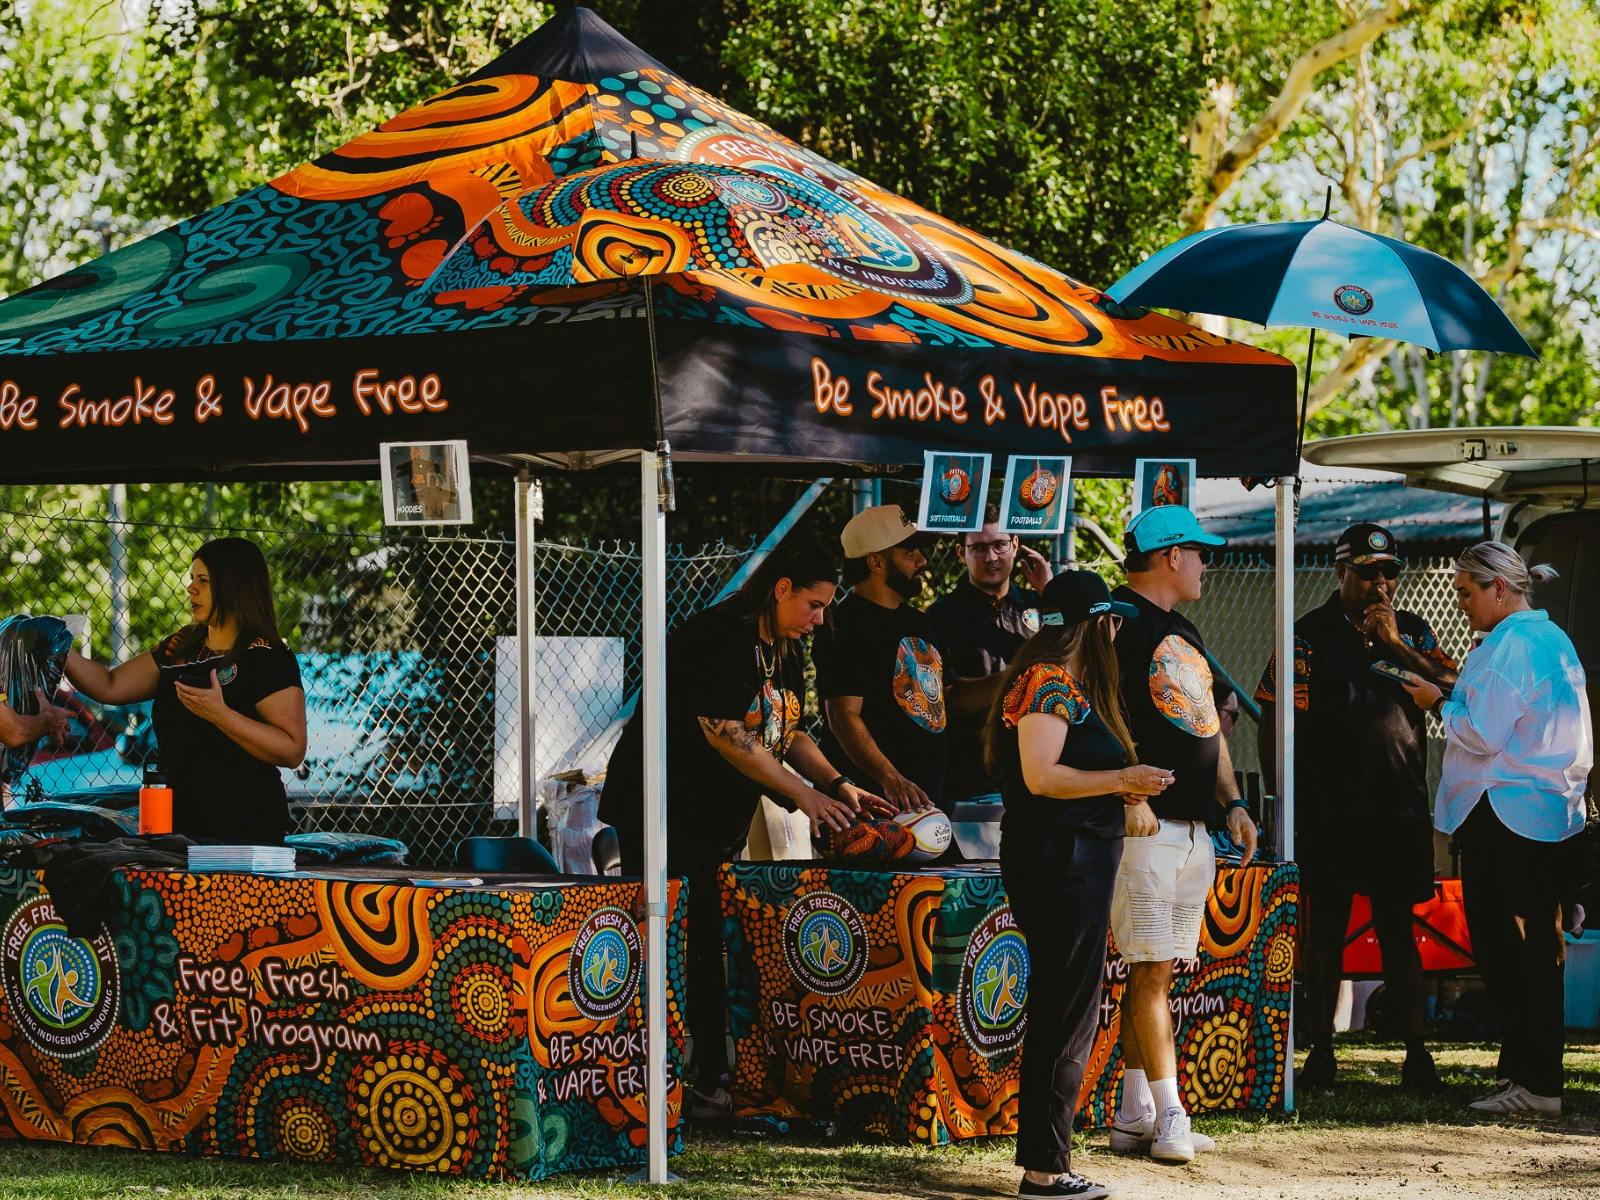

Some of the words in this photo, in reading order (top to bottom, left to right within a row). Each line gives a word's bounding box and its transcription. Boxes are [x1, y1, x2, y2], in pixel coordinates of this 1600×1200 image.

[708, 139, 794, 169] FRESH
[835, 185, 885, 216] FIT
[0, 380, 38, 430] Be
[60, 376, 175, 429] Smoke
[196, 374, 223, 422] &
[243, 374, 336, 433] Vape
[353, 369, 448, 416] Free
[811, 357, 853, 416] Be
[866, 370, 969, 424] Smoke
[979, 374, 1005, 425] &
[1014, 381, 1090, 444] Vape
[1101, 386, 1171, 433] Free
[397, 505, 423, 513] HOODIES
[1010, 516, 1043, 525] FOOTBALLS
[7, 917, 33, 961] FREE,
[31, 904, 65, 925] FRE
[93, 935, 112, 963] FIT
[594, 913, 622, 929] FRESH
[620, 922, 629, 936] &
[626, 933, 638, 951] FIT
[789, 905, 810, 933] FREE,
[809, 897, 842, 913] FRESH
[841, 908, 850, 921] &
[848, 919, 862, 937] FIT
[967, 927, 994, 968] FREE,
[995, 912, 1018, 932] FRE
[178, 958, 253, 999] Free,
[266, 962, 349, 1000] Fresh
[621, 968, 637, 1000] SMOKING
[790, 947, 810, 978] TACKLING
[809, 975, 846, 988] INDIGENOUS
[845, 953, 862, 981] SMOKING
[12, 985, 37, 1035] TACKLING
[37, 1028, 90, 1046] INDIGENOUS
[89, 988, 113, 1034] SMOKING
[772, 1001, 799, 1027] BE
[809, 1008, 890, 1035] SMOKE
[1168, 992, 1225, 1036] gram
[154, 1004, 178, 1038] &
[190, 1008, 237, 1042] Fit
[250, 1005, 382, 1070] Program
[550, 1035, 573, 1064] BE
[763, 1033, 776, 1056] &
[784, 1038, 839, 1066] VAPE
[537, 1078, 547, 1105] &
[554, 1068, 606, 1101] VAPE
